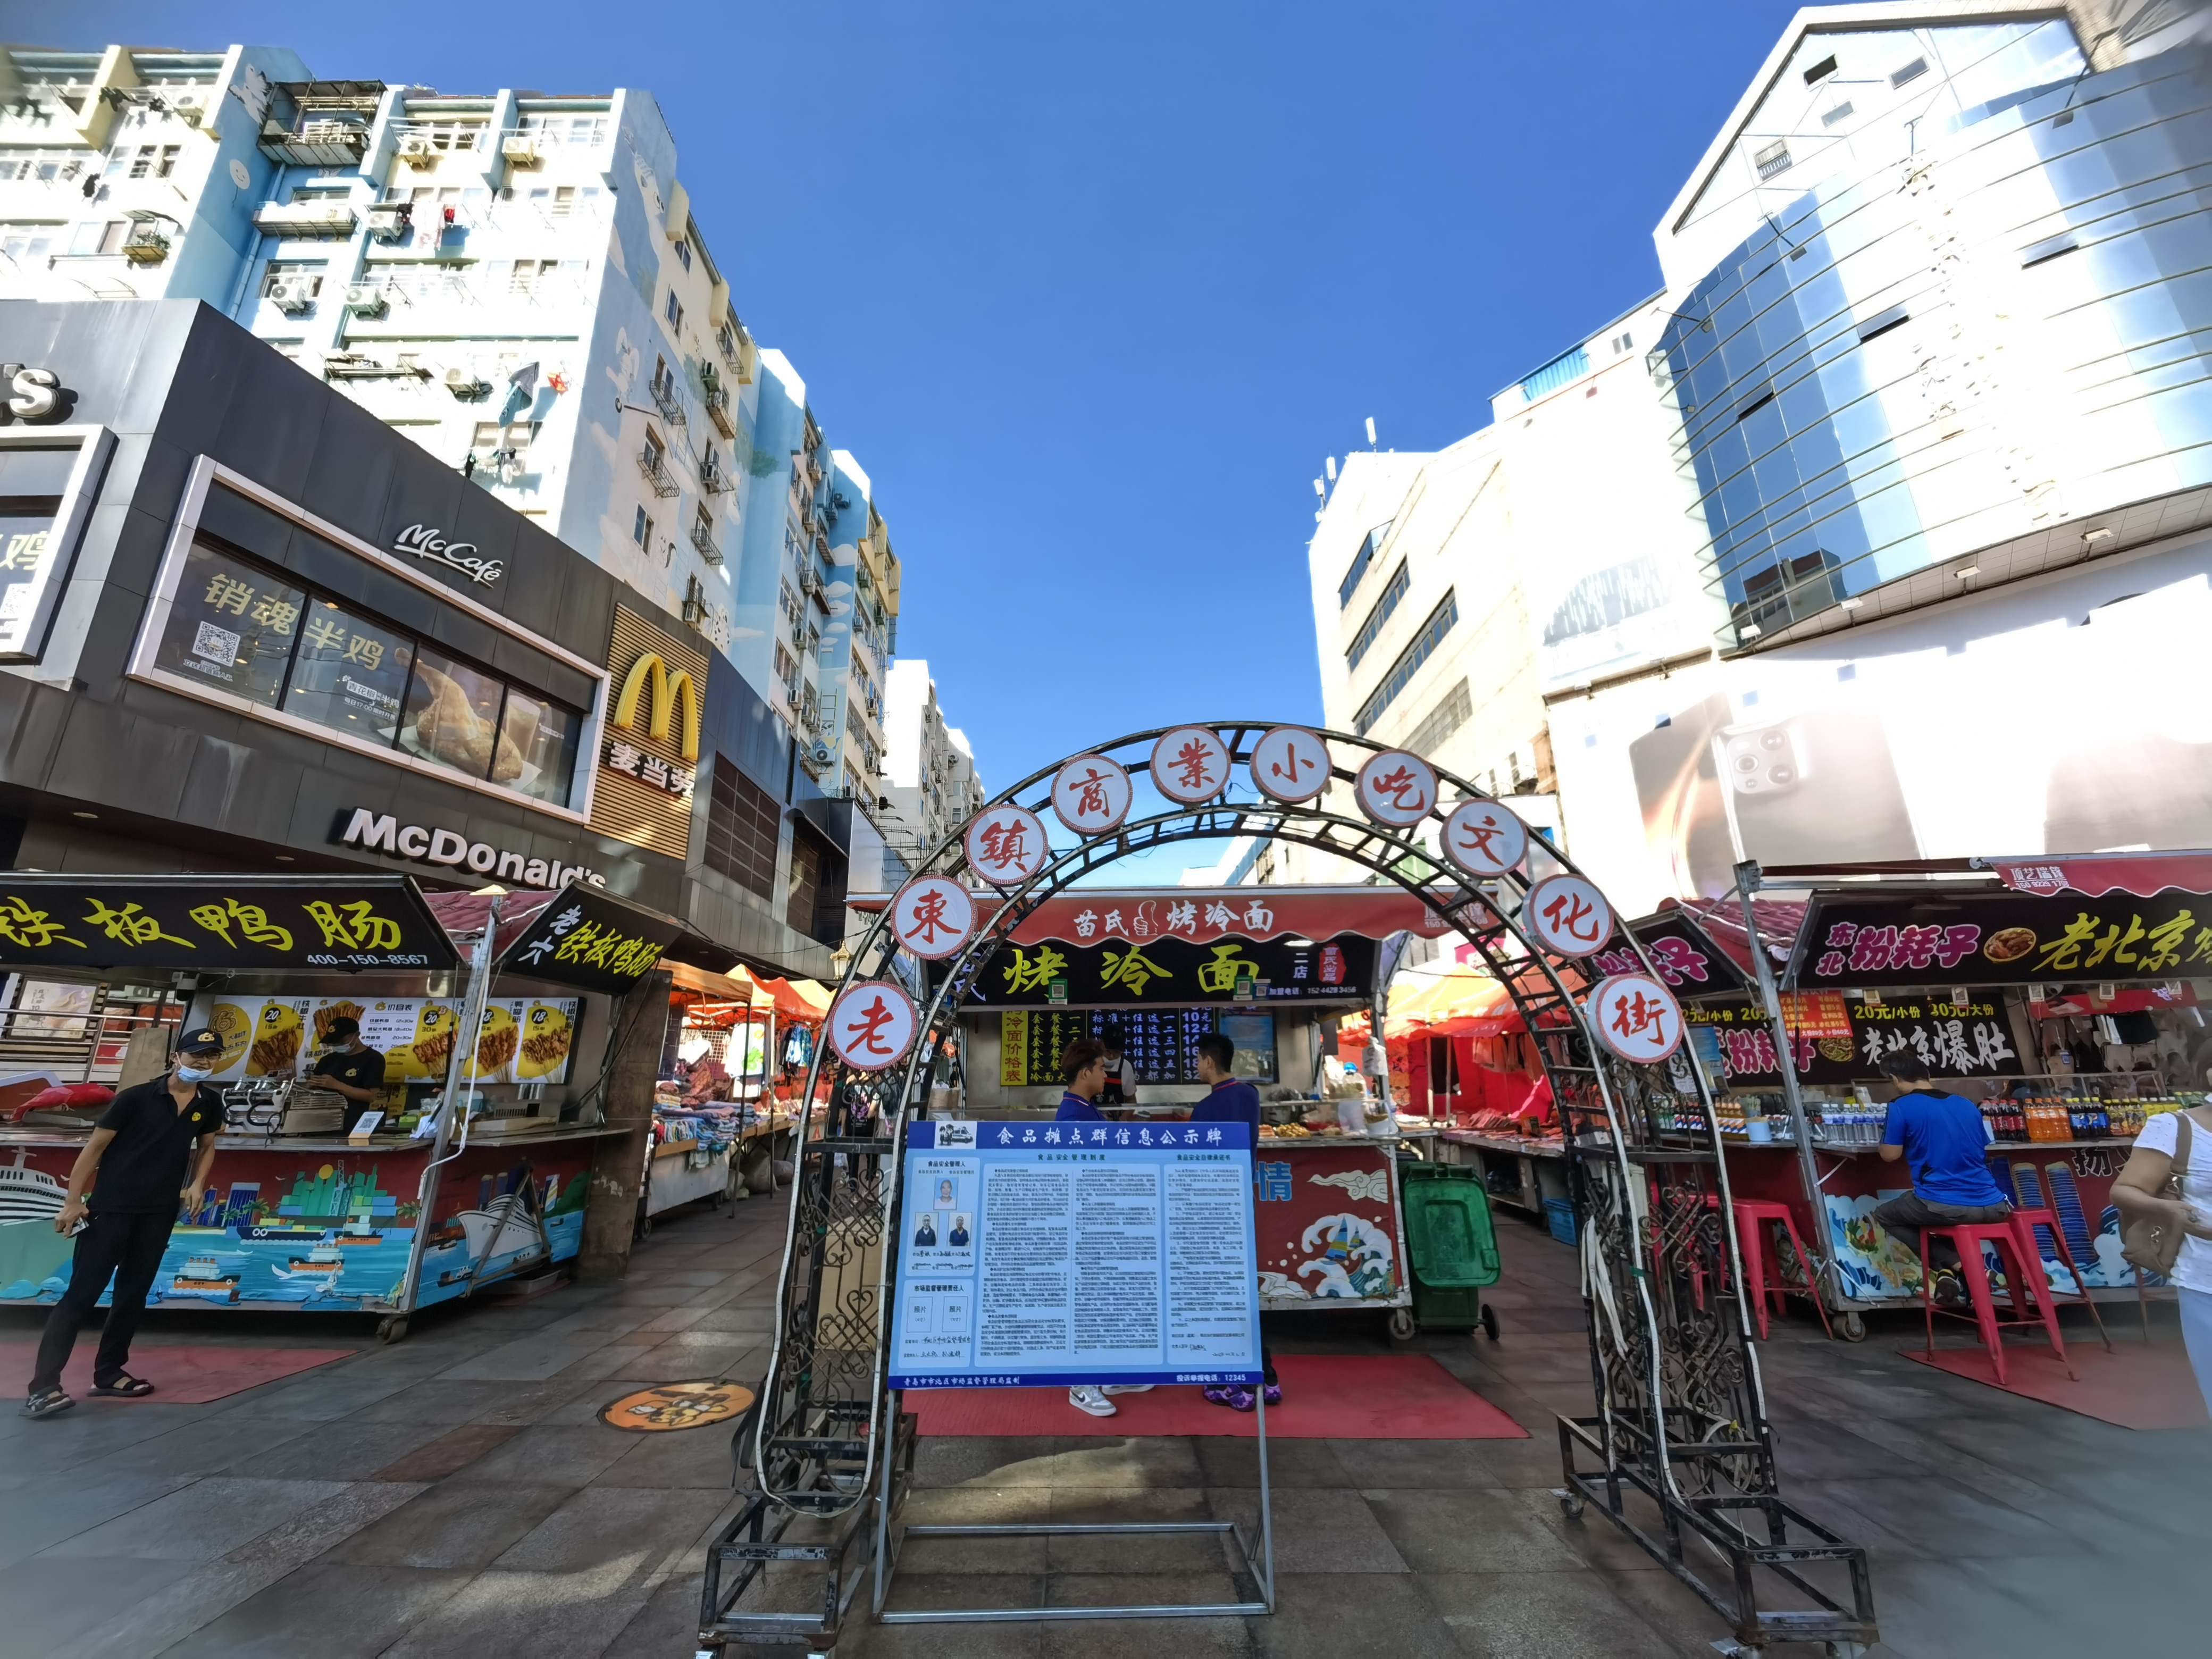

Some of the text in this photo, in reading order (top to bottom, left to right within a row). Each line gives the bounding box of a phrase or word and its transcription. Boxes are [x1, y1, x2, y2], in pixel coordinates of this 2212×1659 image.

[396, 524, 502, 587] McCafé
[204, 573, 385, 671] 销魂半鸡
[609, 742, 694, 798] 麦当劳
[342, 807, 606, 889] McDonald's
[0, 896, 401, 951] 铁板鸭肠
[1073, 900, 1274, 937] 苗氏 烤冷面
[306, 954, 428, 965] 400-150-8567
[1293, 952, 1309, 979] 二店
[1815, 921, 1858, 976] 东北
[1848, 924, 1981, 971] 粉耗子
[1003, 944, 1260, 999] 烤冷面
[265, 1010, 280, 1020] 20
[425, 1014, 438, 1024] 20
[533, 1011, 547, 1021] 18
[1182, 1012, 1212, 1022] 10元
[1182, 1023, 1212, 1033] 12元
[1854, 1003, 1921, 1020] 20元/小份
[1930, 1003, 1994, 1018] 30元/大份
[1004, 1011, 1024, 1082] 冷面价格表
[1862, 1019, 2015, 1076] 老北京爆肚
[996, 1127, 1224, 1146] 食品摊点群信息公示牌
